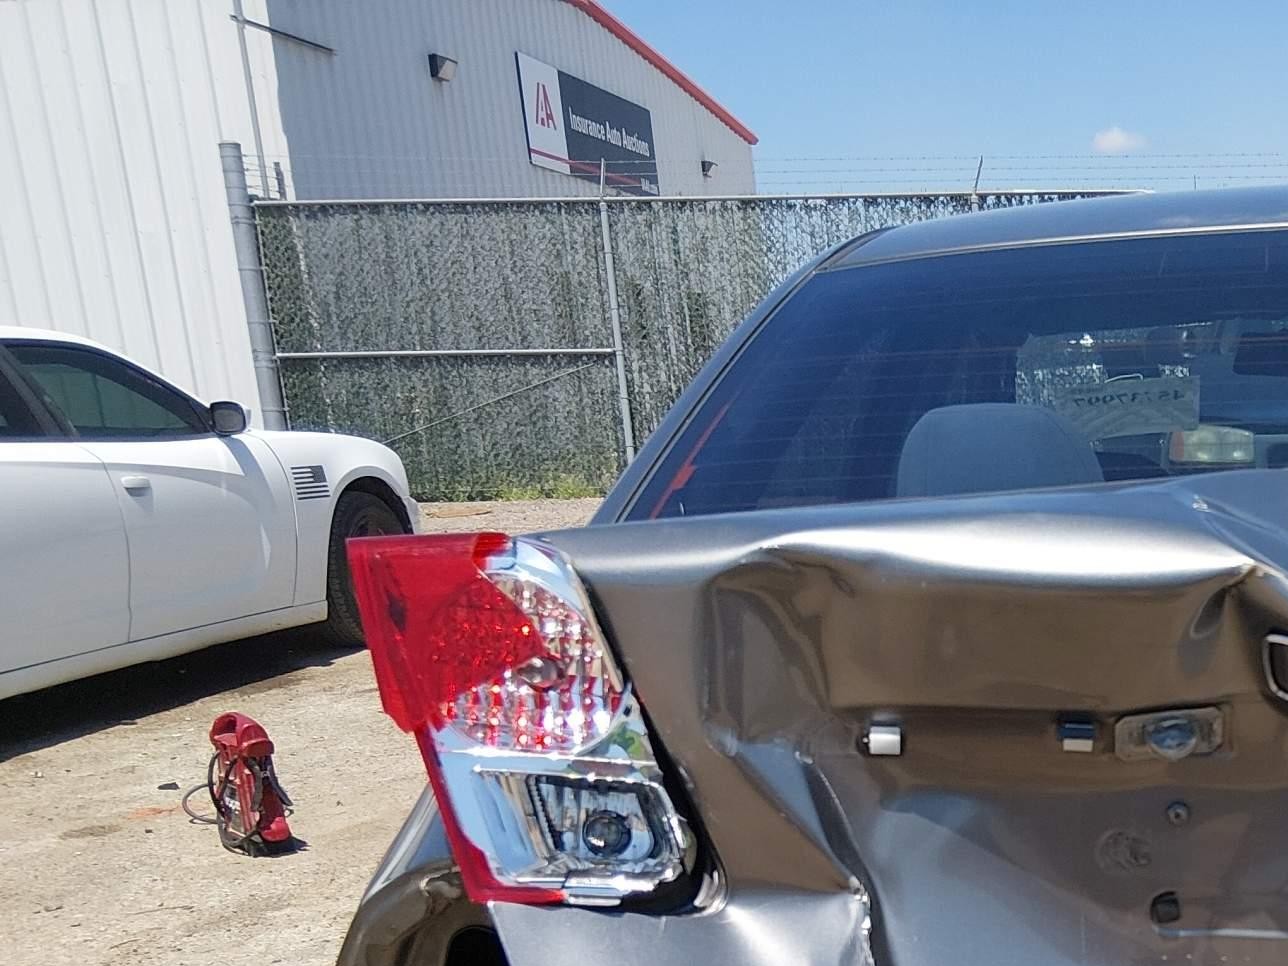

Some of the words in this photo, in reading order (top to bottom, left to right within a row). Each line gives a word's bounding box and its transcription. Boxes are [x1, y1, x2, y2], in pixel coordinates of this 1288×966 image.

[568, 106, 606, 141] Insurance
[606, 121, 622, 147] Auto
[622, 128, 650, 157] Auctions
